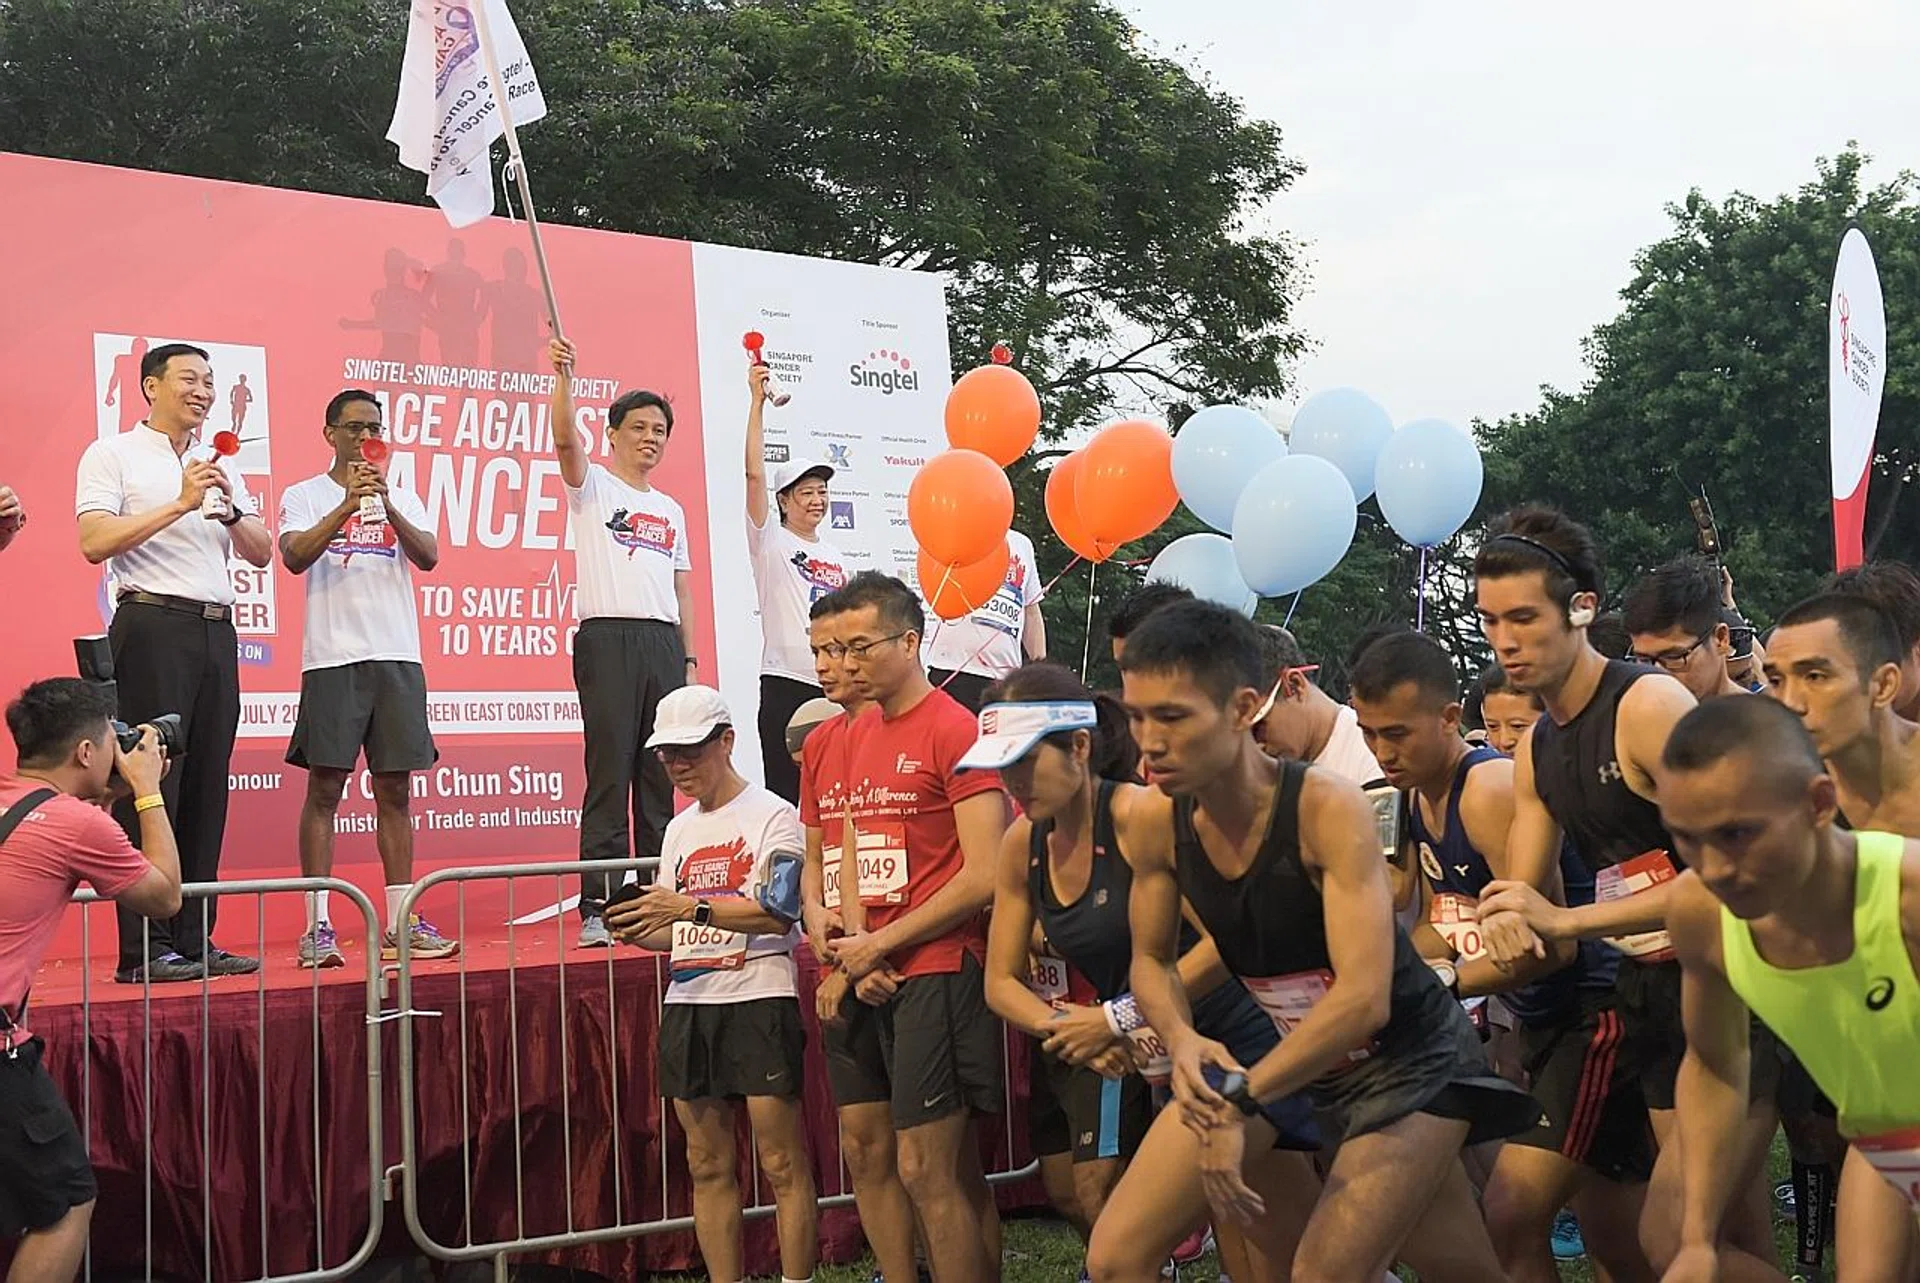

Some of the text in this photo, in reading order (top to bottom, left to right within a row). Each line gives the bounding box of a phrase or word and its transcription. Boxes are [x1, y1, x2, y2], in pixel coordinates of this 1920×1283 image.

[508, 80, 536, 102] Race
[767, 351, 814, 363] SINGAPORE
[343, 358, 620, 401] SINGTEL-SINGAPORE CANCER OCIETY
[850, 364, 919, 395] Singtel
[375, 390, 611, 458] ACE AGAIST
[884, 456, 926, 467] Yakult
[386, 451, 577, 550] ANCE
[420, 586, 453, 617] TO
[461, 586, 524, 619] SAVE
[440, 624, 469, 656] 10
[479, 625, 557, 657] YEARS
[245, 644, 262, 660] ON
[242, 704, 277, 724] JULY
[427, 703, 460, 722] REEN
[507, 702, 550, 721] COAST
[554, 702, 580, 721] PAR
[228, 771, 282, 791] onour
[436, 766, 501, 797] Chun
[508, 764, 563, 801] Sing
[426, 808, 475, 830] Trade
[479, 807, 510, 828] and
[515, 806, 583, 830] Industry
[859, 858, 896, 880] 049
[687, 871, 729, 892] CANCER
